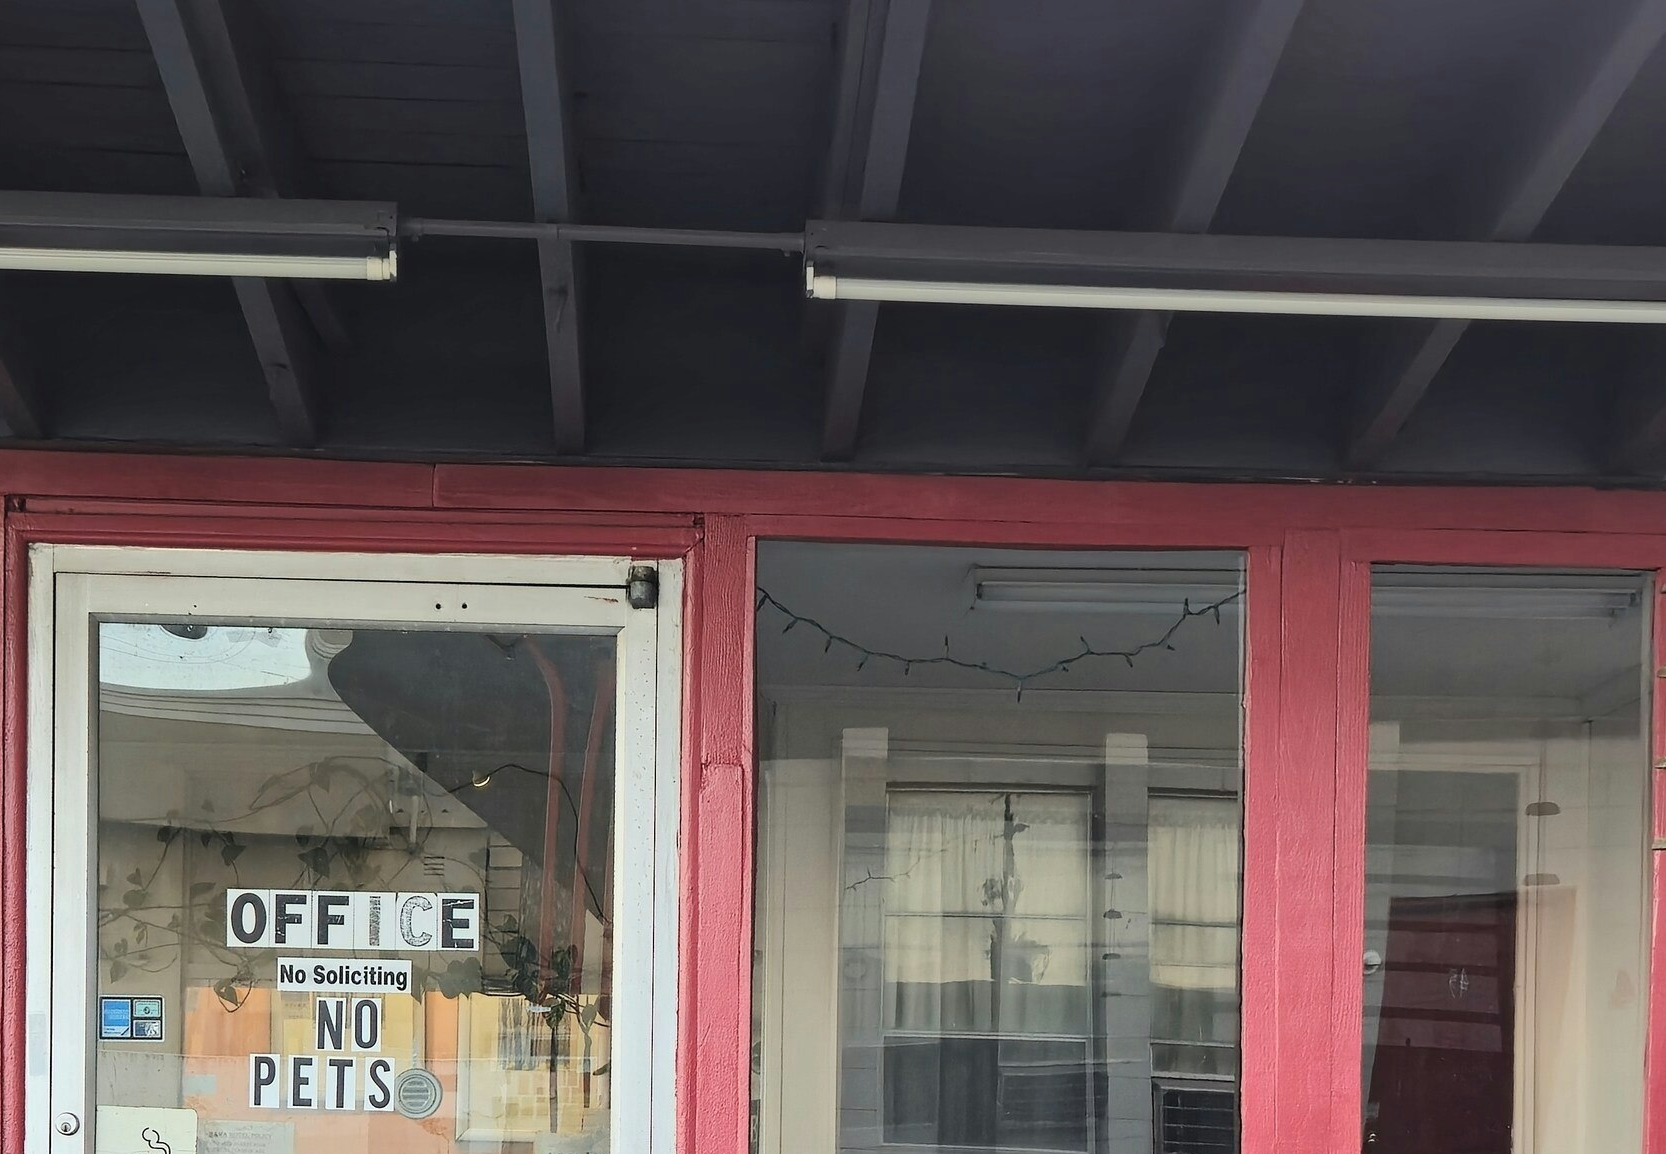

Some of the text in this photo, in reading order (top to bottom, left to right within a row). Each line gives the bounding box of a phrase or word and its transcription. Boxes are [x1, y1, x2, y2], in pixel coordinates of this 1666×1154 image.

[230, 891, 476, 949] OFFICE
[281, 965, 407, 991] No Soliciting
[317, 999, 378, 1050] NO
[253, 1056, 392, 1110] PETS
